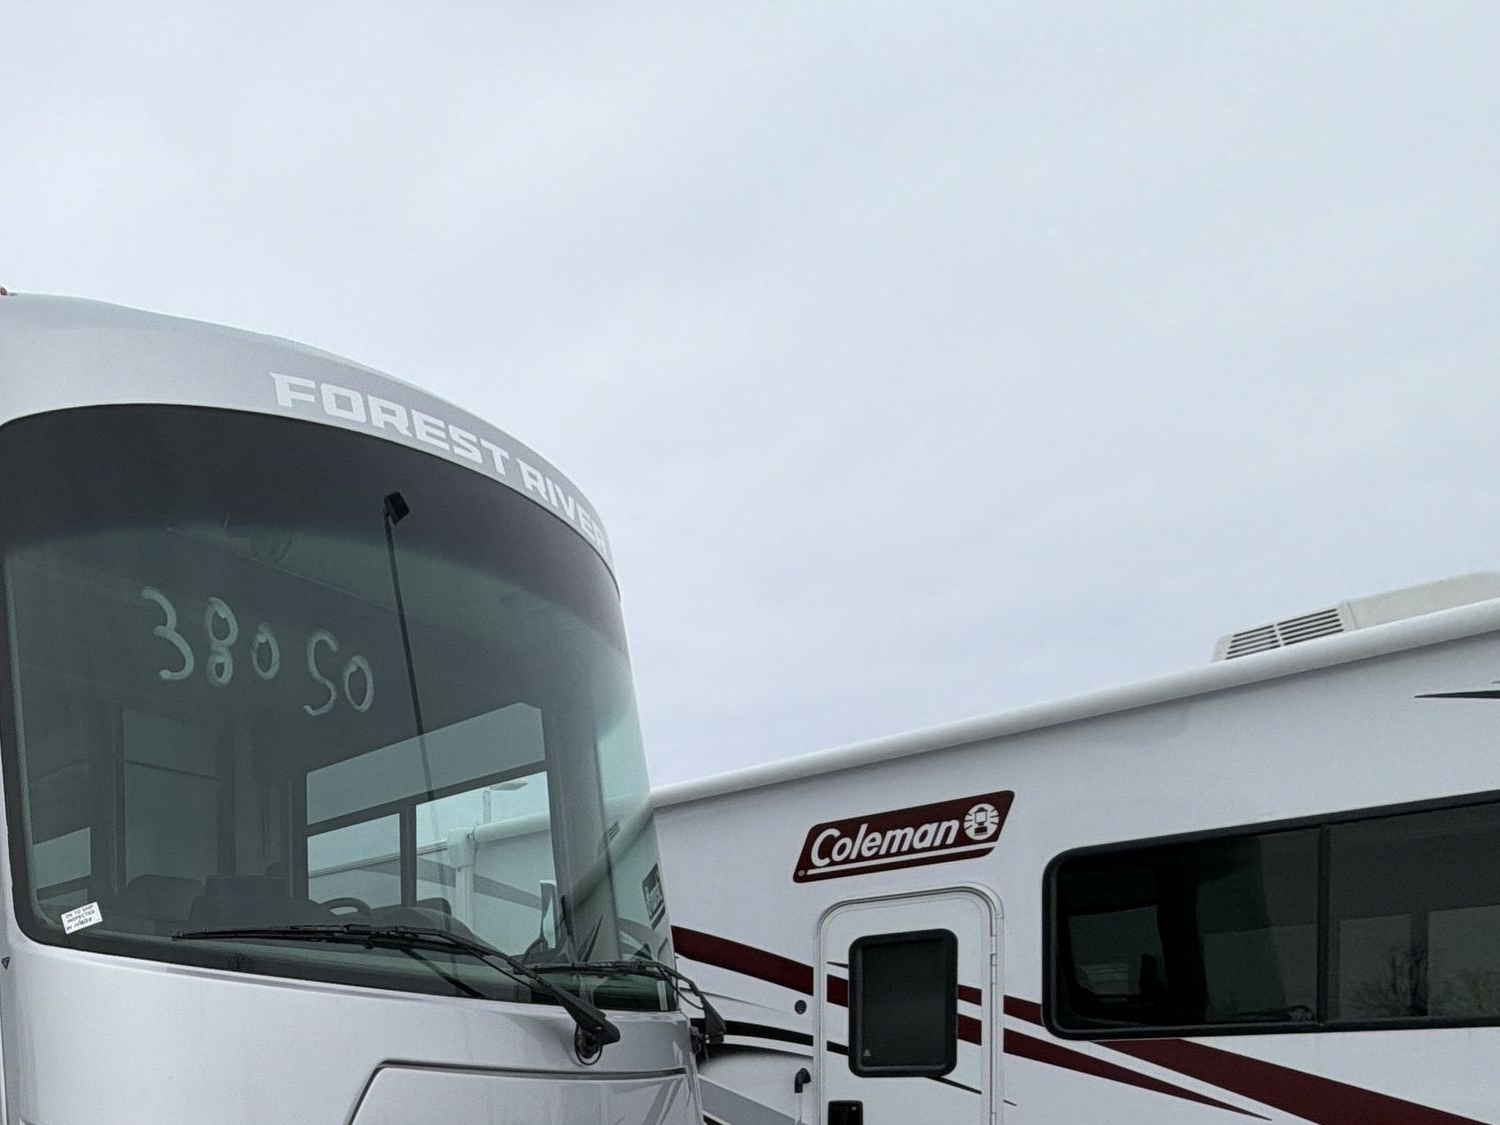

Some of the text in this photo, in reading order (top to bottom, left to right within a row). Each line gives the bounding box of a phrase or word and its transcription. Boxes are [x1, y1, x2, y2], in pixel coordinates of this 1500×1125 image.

[269, 372, 607, 557] FOREST RIVER
[811, 822, 960, 867] Coleman
